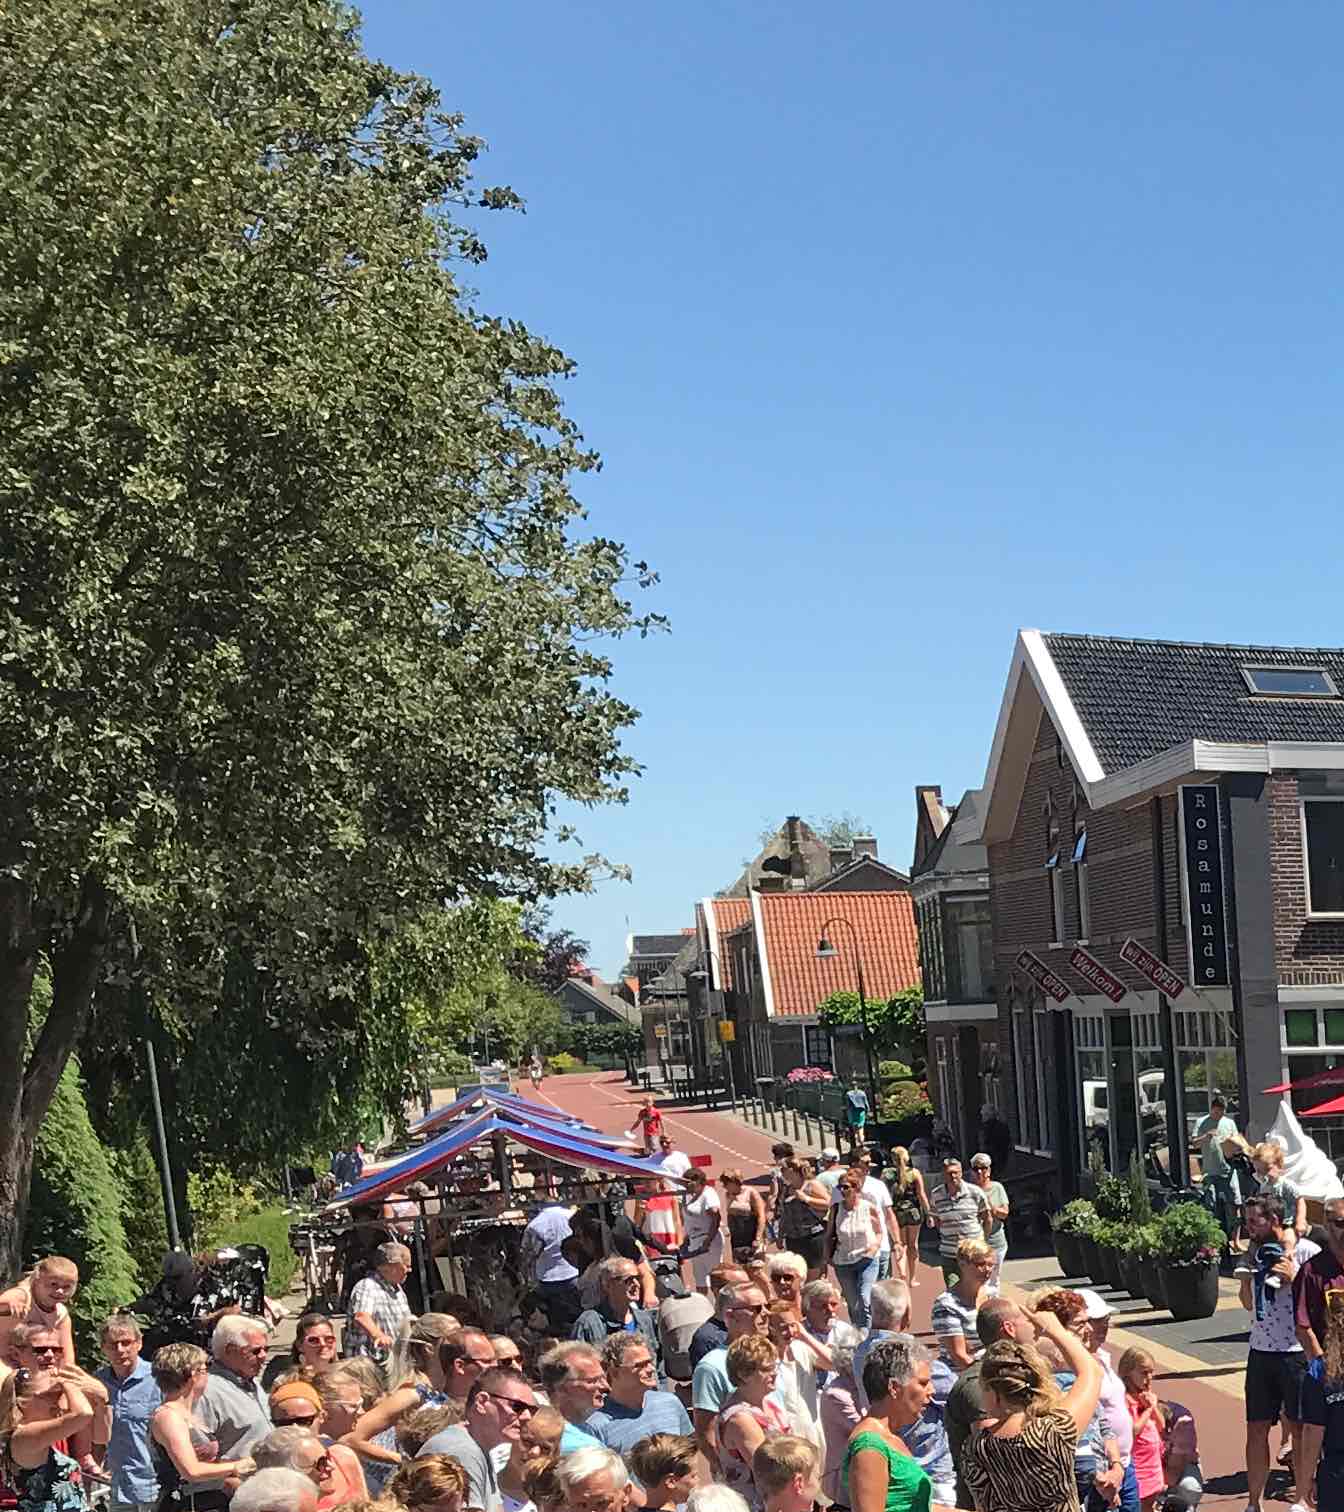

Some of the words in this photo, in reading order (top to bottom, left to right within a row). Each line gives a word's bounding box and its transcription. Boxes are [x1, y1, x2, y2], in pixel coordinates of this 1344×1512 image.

[1194, 793, 1216, 979] Rosamunde
[1042, 975, 1066, 1000] OPEN
[1153, 967, 1180, 993] OPEN
